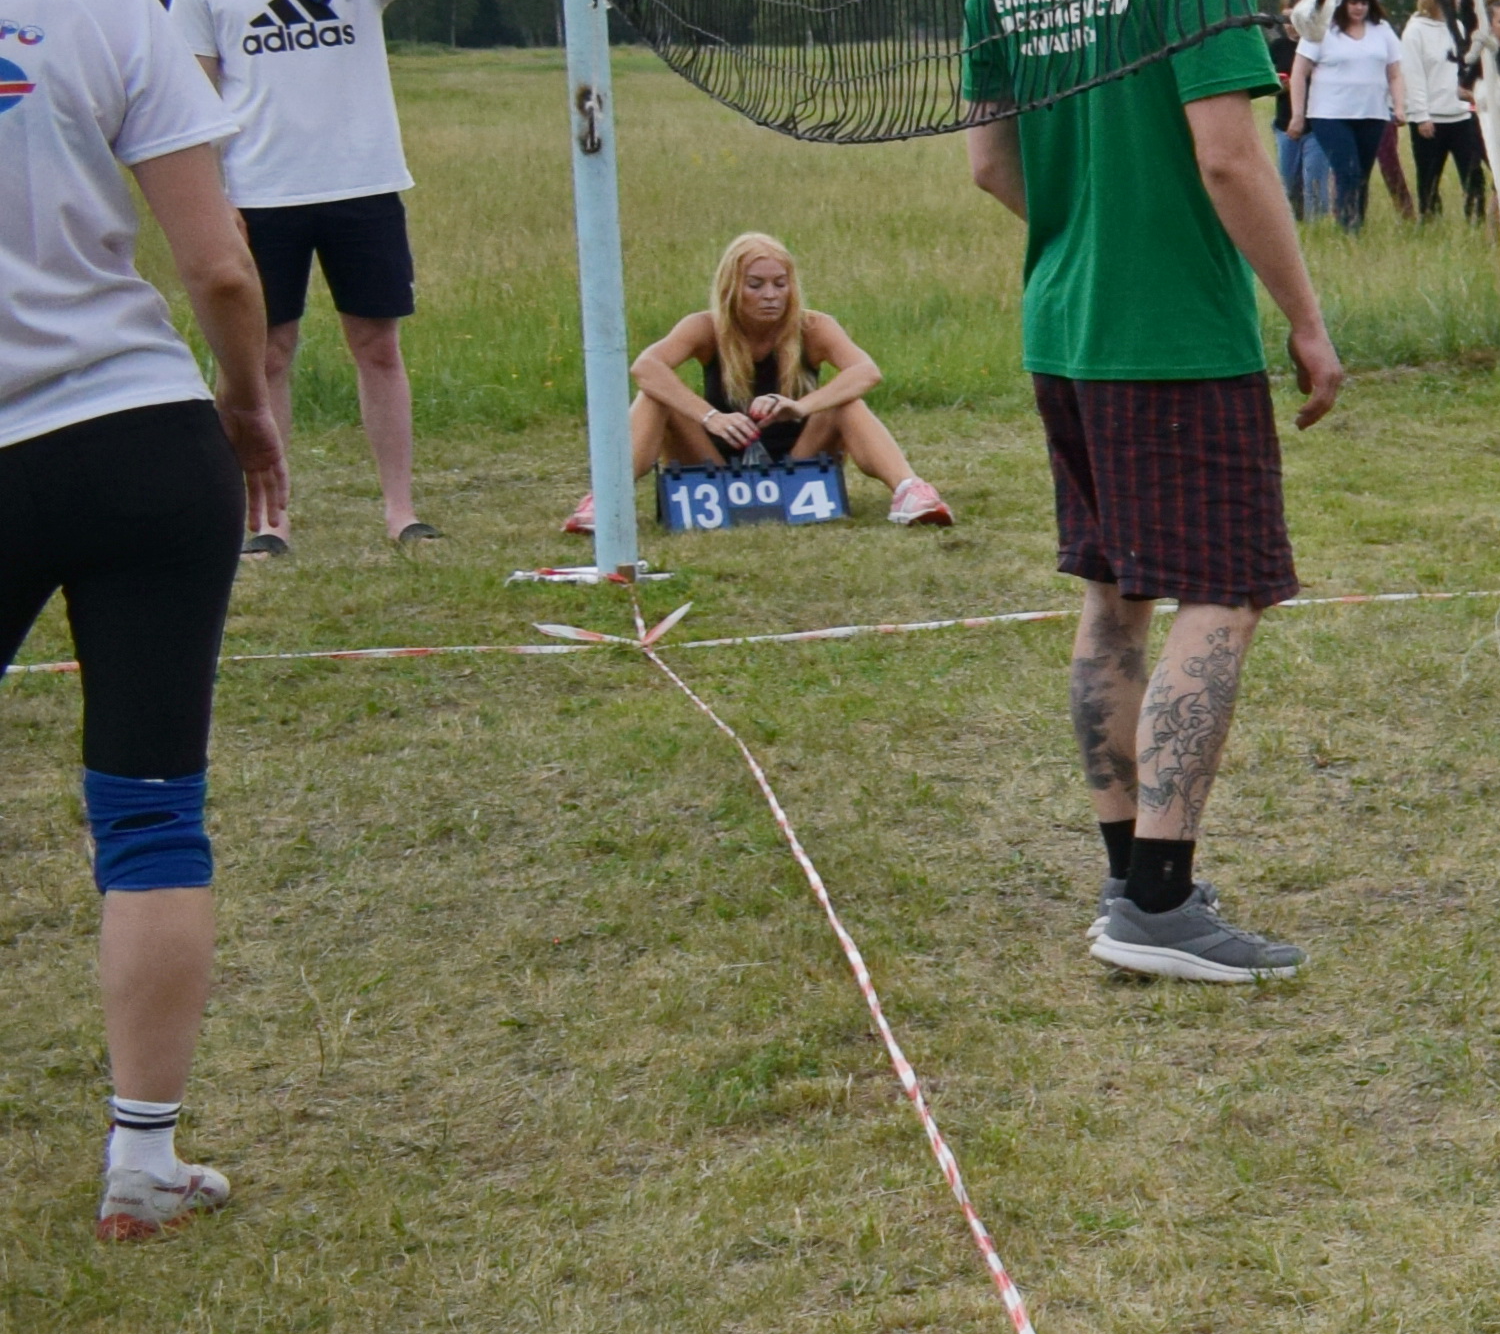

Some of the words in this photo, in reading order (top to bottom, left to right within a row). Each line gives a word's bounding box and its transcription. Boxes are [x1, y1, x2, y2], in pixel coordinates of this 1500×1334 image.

[242, 22, 356, 55] adidas
[671, 483, 723, 530] 13
[789, 480, 836, 519] 4
